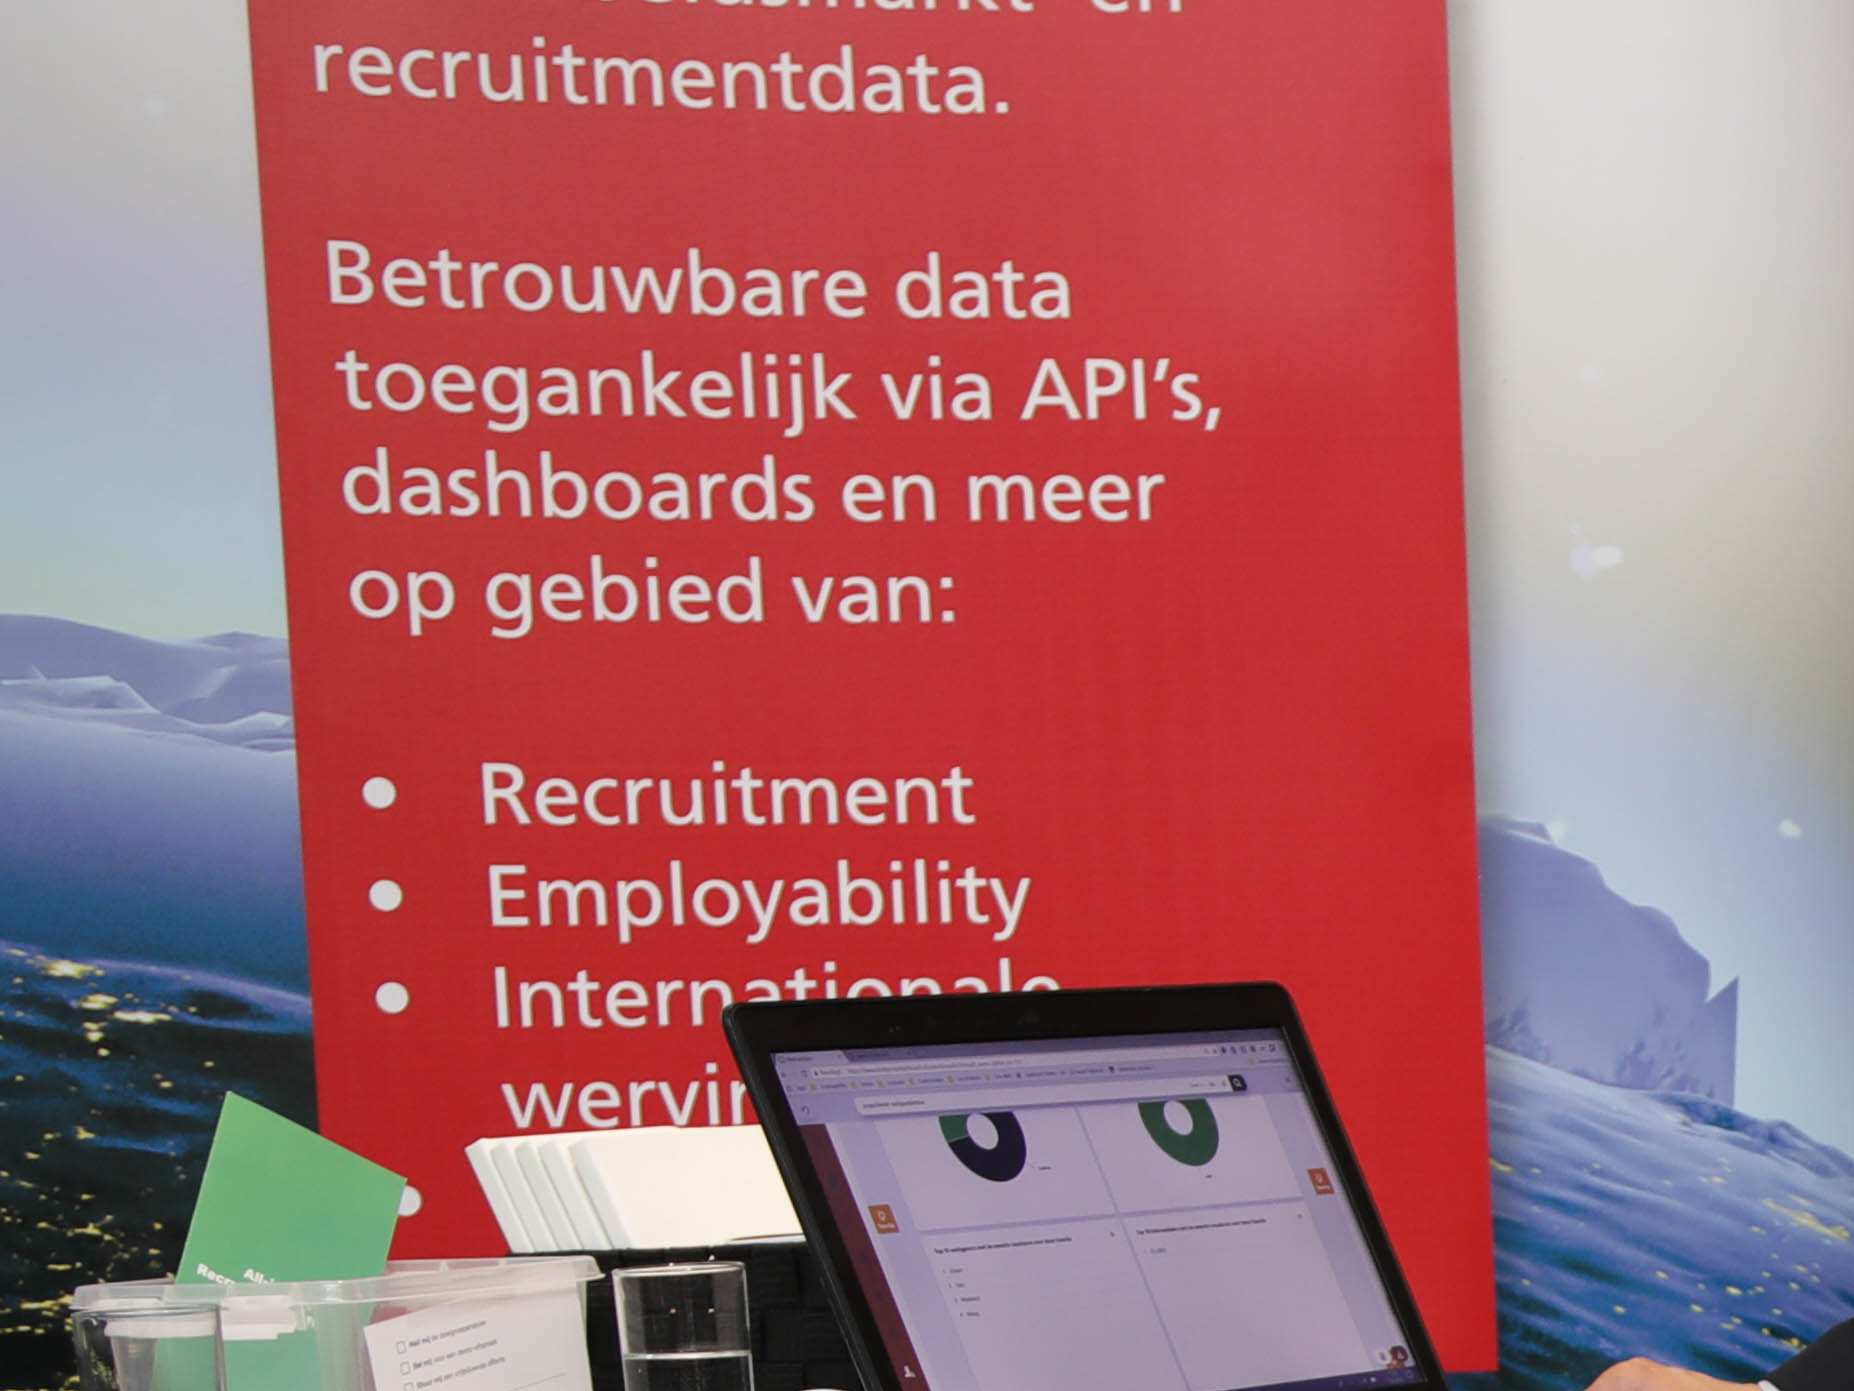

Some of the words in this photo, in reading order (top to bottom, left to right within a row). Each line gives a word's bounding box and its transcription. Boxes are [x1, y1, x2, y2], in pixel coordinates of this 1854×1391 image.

[313, 36, 1010, 115] recruitmentdata.
[326, 238, 868, 319] Betrouwbare
[895, 250, 1072, 320] data
[335, 347, 857, 438] toegankelijk
[880, 355, 992, 421] via
[342, 445, 815, 522] dashboards
[841, 473, 936, 522] en
[967, 472, 1166, 523] meer
[349, 568, 455, 636] op
[484, 553, 764, 639] gebied
[791, 573, 957, 624] van:
[481, 759, 976, 826] Recruitment
[488, 858, 1031, 943] Employability
